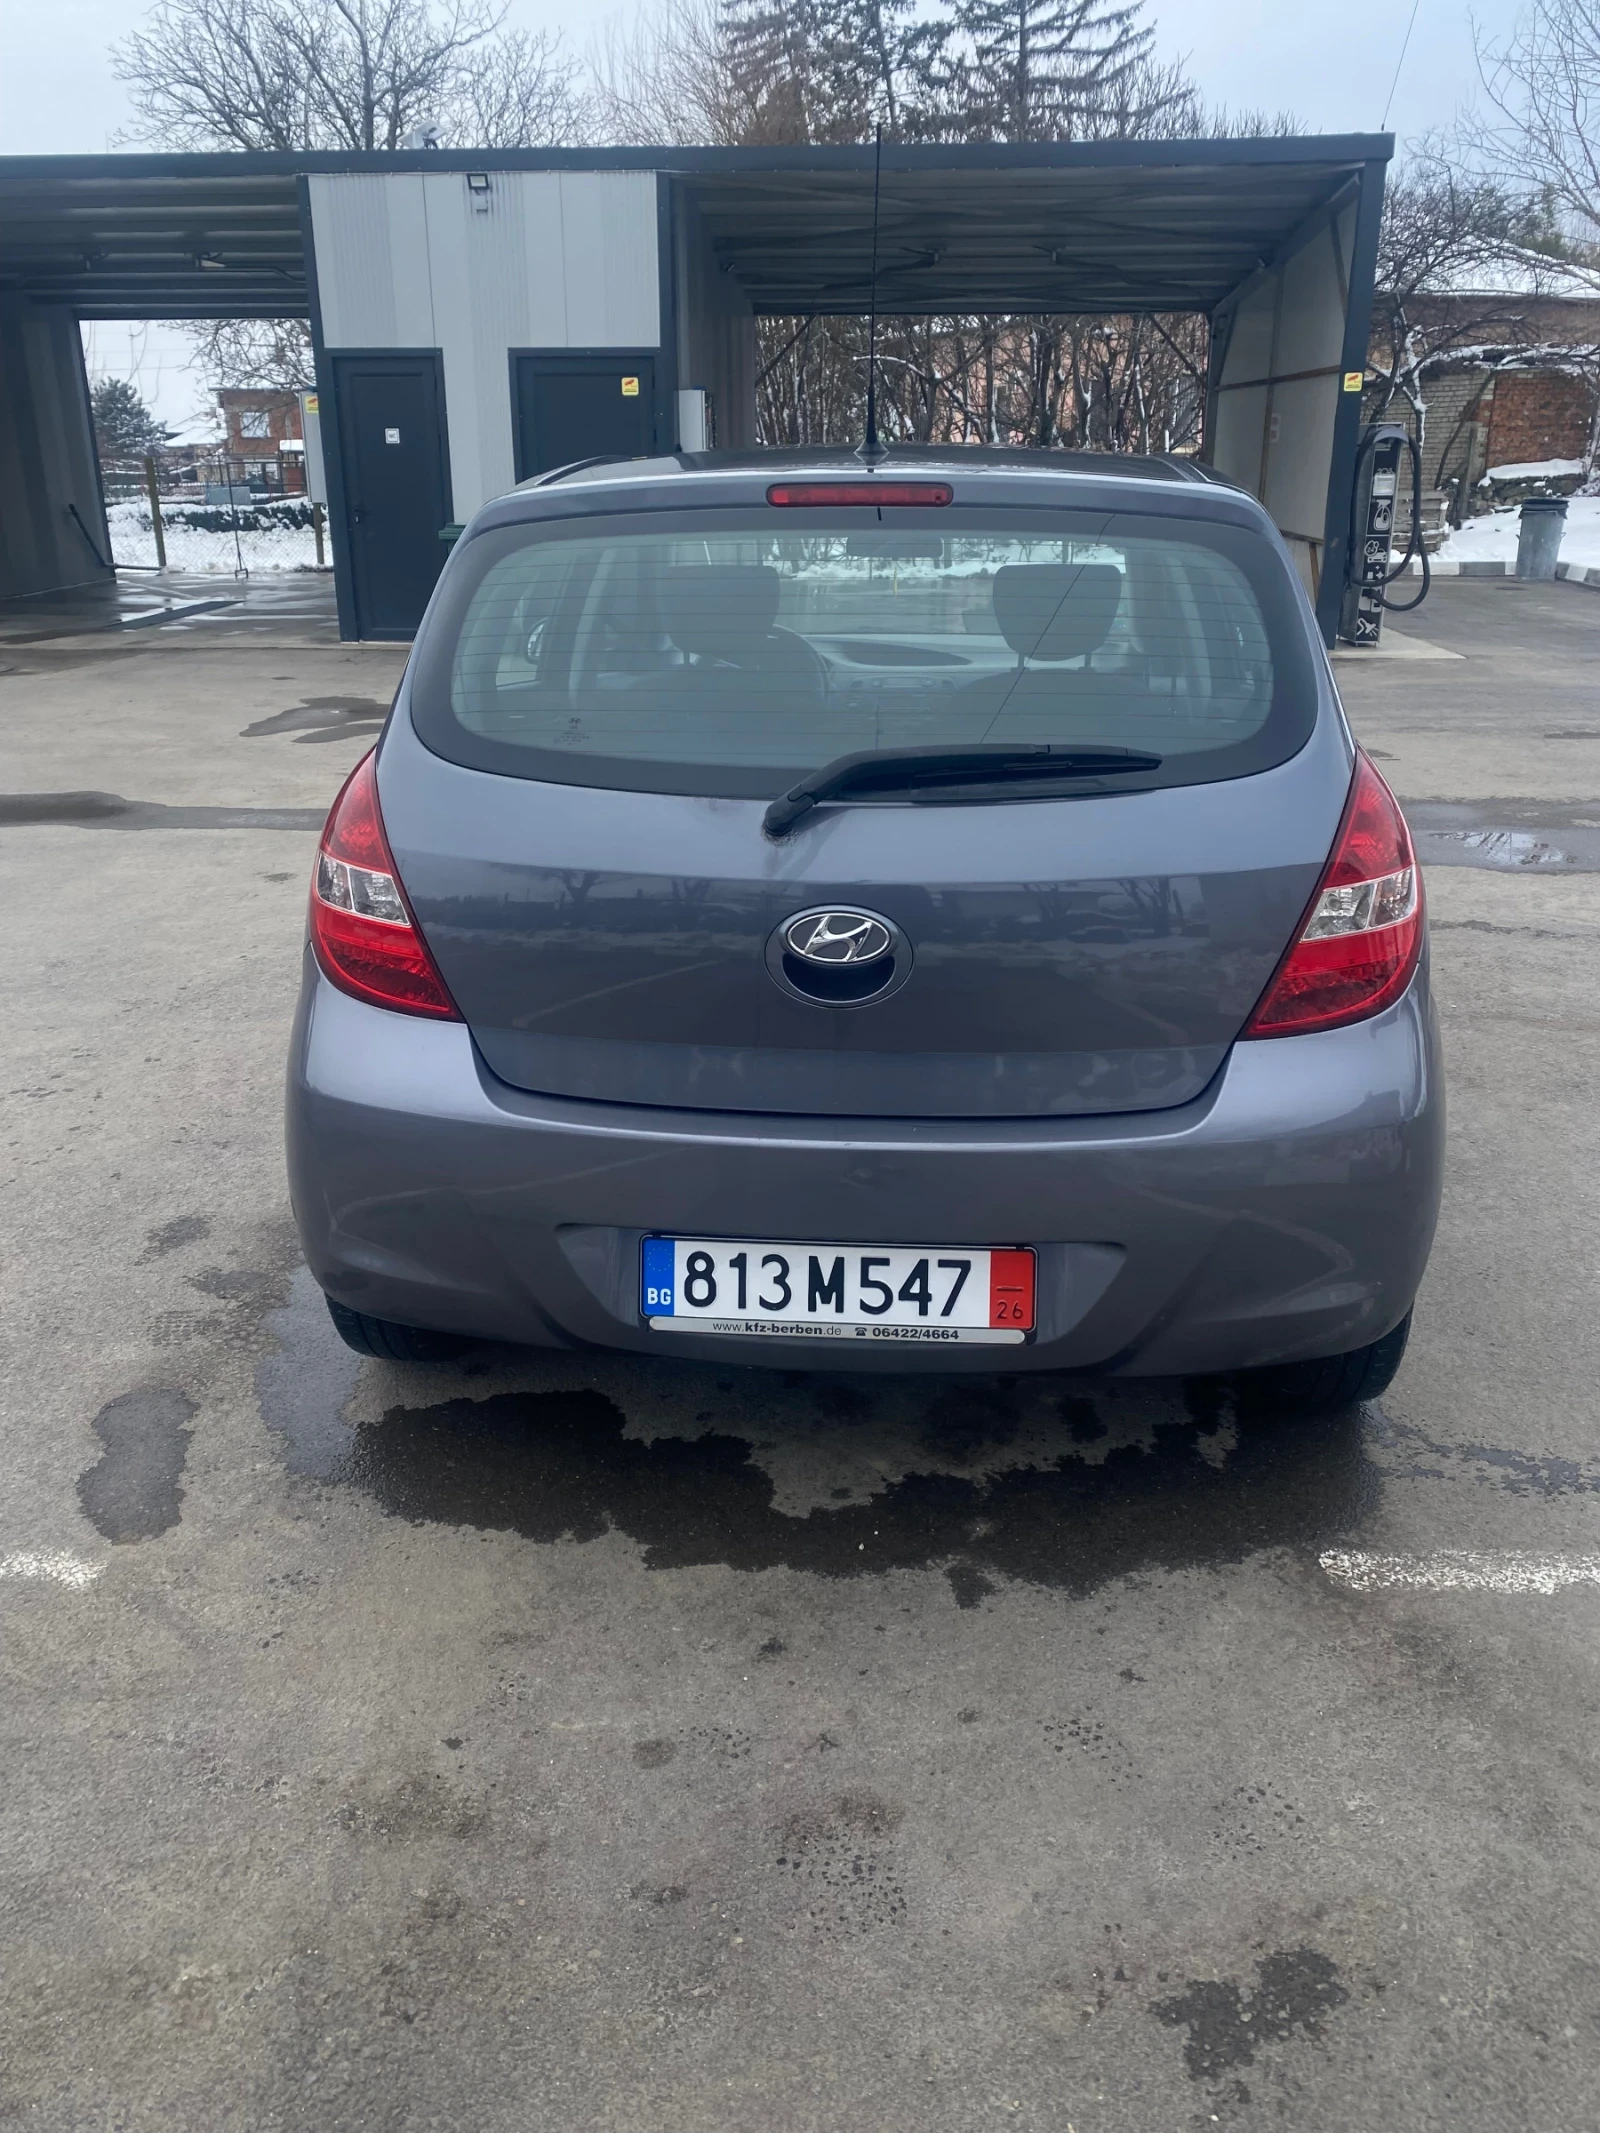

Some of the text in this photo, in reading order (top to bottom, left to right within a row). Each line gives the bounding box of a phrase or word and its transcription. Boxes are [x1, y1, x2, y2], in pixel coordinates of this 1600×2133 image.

[647, 1287, 671, 1305] BG
[996, 1300, 1023, 1320] 26
[712, 1322, 959, 1340] www.kfz-berben.de 06422/4664
